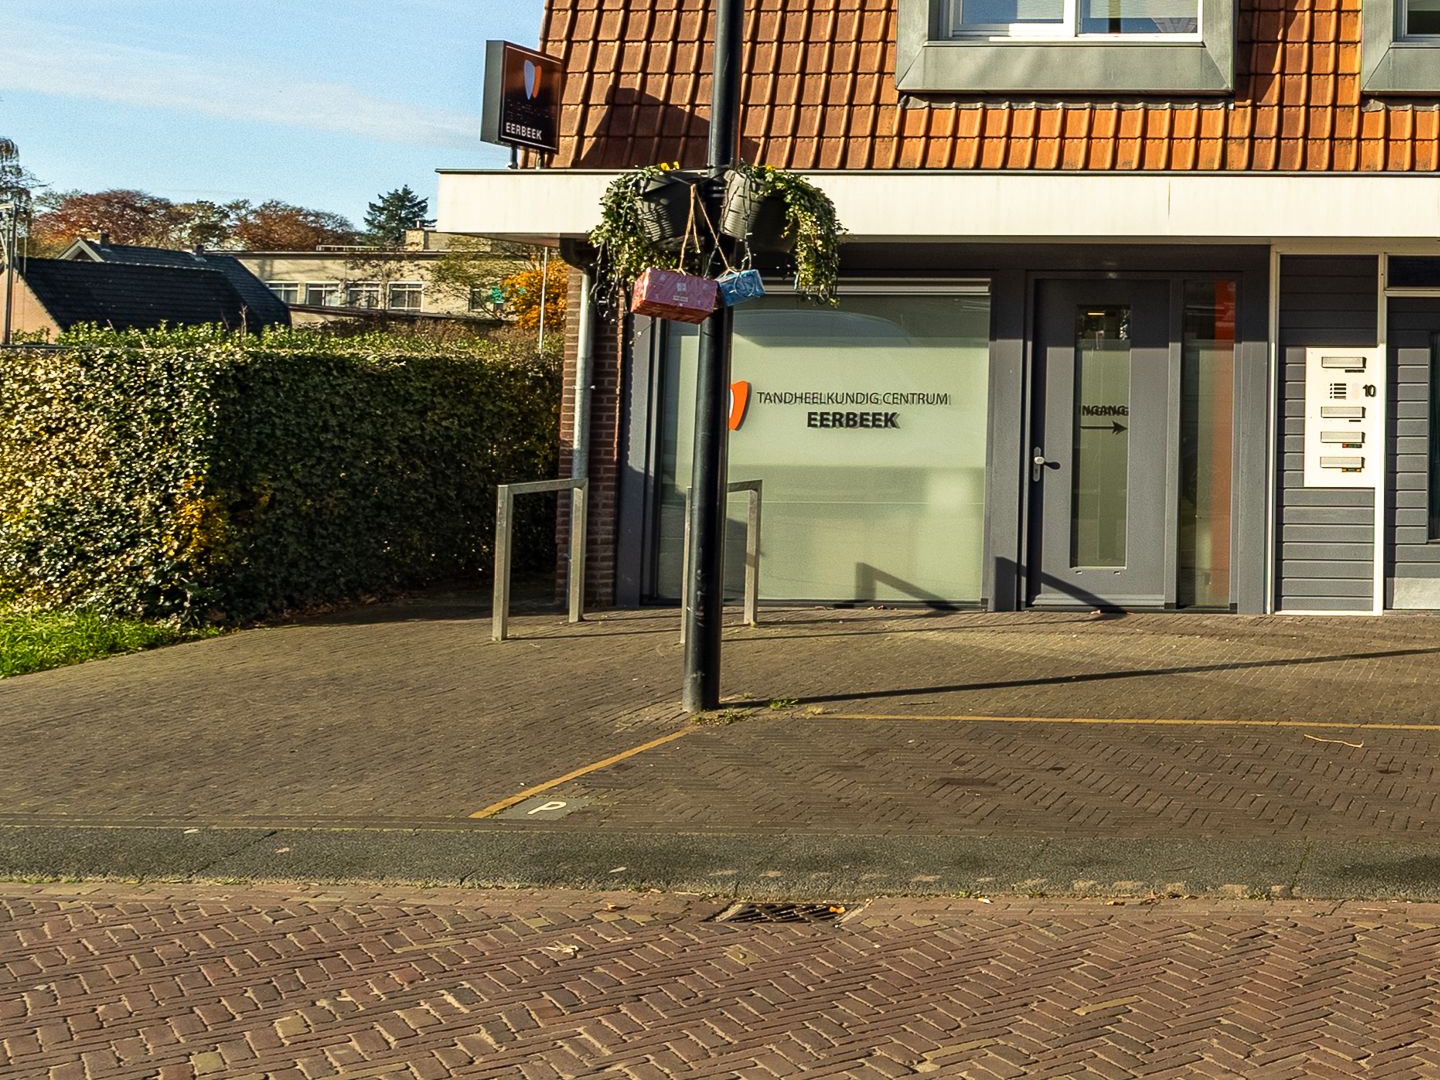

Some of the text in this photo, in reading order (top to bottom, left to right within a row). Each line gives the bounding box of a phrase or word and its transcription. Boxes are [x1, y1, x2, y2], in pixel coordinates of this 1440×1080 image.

[505, 122, 542, 140] EERBEEK
[1363, 384, 1376, 397] 10
[757, 392, 949, 406] TANDHEELKUNDIG CENTRUM
[1079, 405, 1127, 416] INGANG
[807, 411, 898, 428] EERBEEK
[527, 801, 567, 815] P
